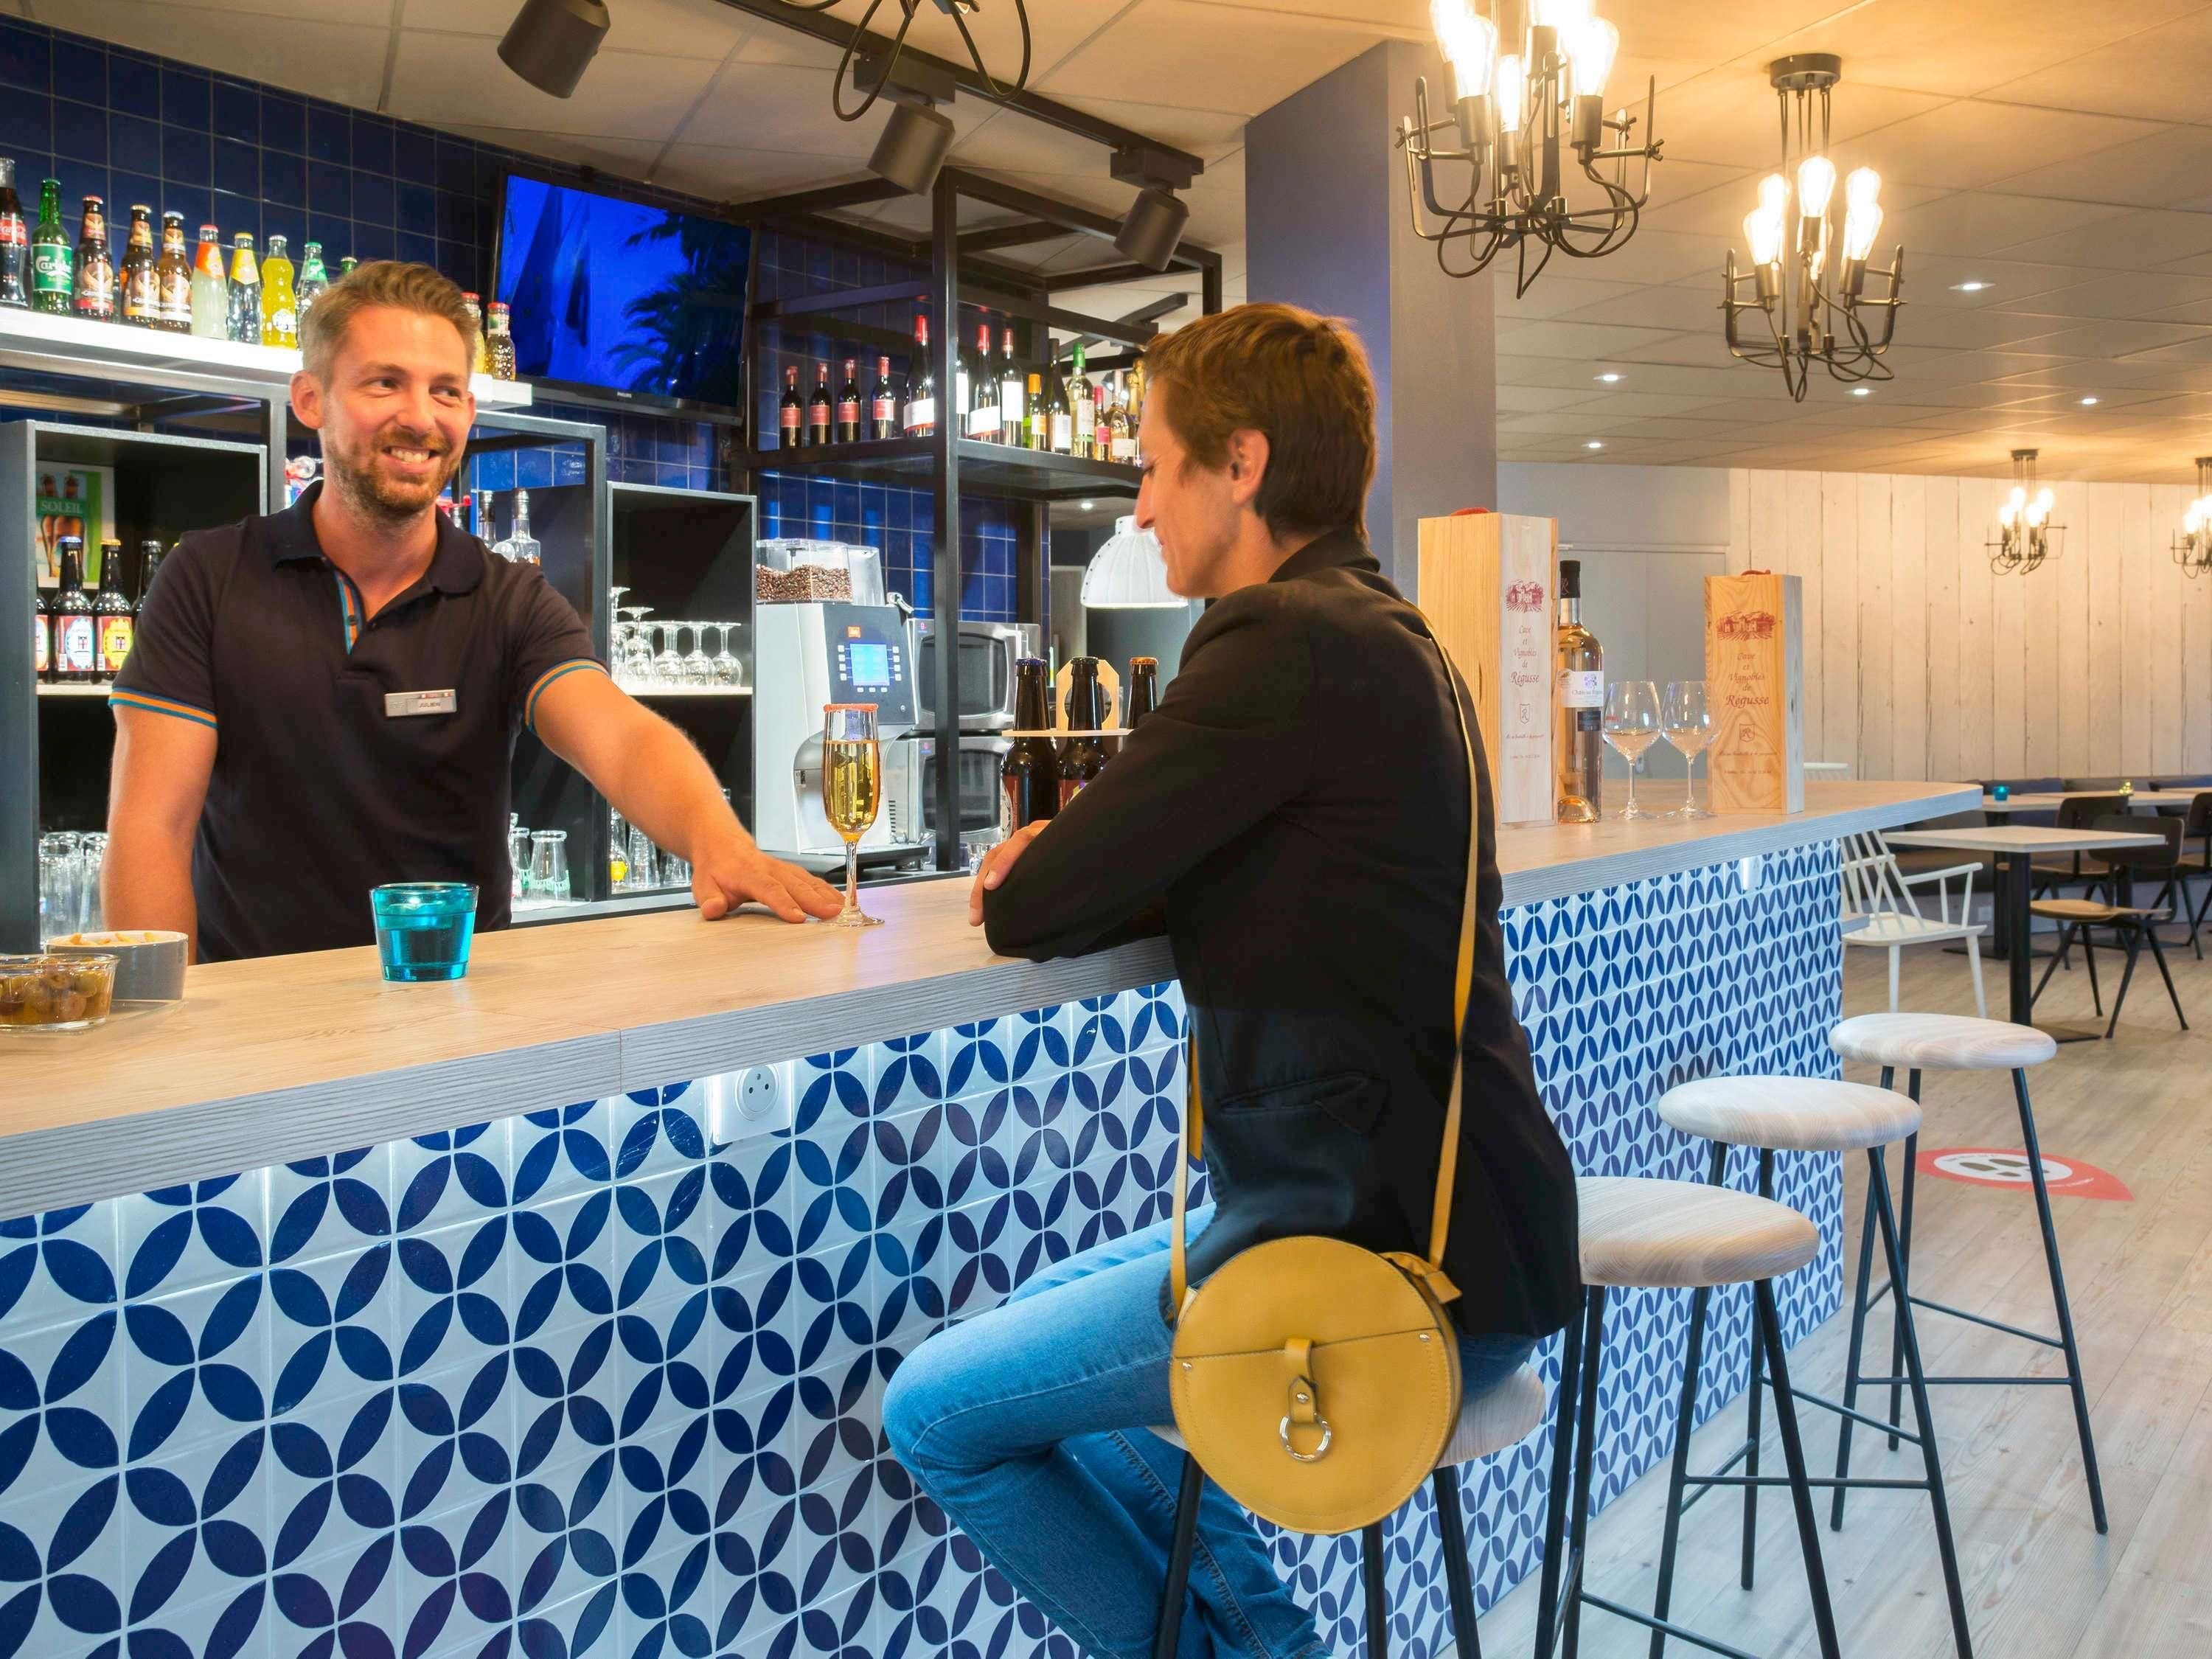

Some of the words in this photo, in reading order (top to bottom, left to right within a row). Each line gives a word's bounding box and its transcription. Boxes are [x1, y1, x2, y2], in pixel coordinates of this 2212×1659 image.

[41, 499, 83, 515] SOLEIL
[1518, 625, 1532, 635] Cave
[1513, 647, 1537, 659] Vignobles
[1736, 652, 1756, 661] Cave
[1522, 659, 1528, 668] de
[1511, 670, 1540, 687] Régusse
[1728, 672, 1765, 684] Vignobles
[1742, 683, 1752, 692] de
[1725, 694, 1770, 709] Régusse
